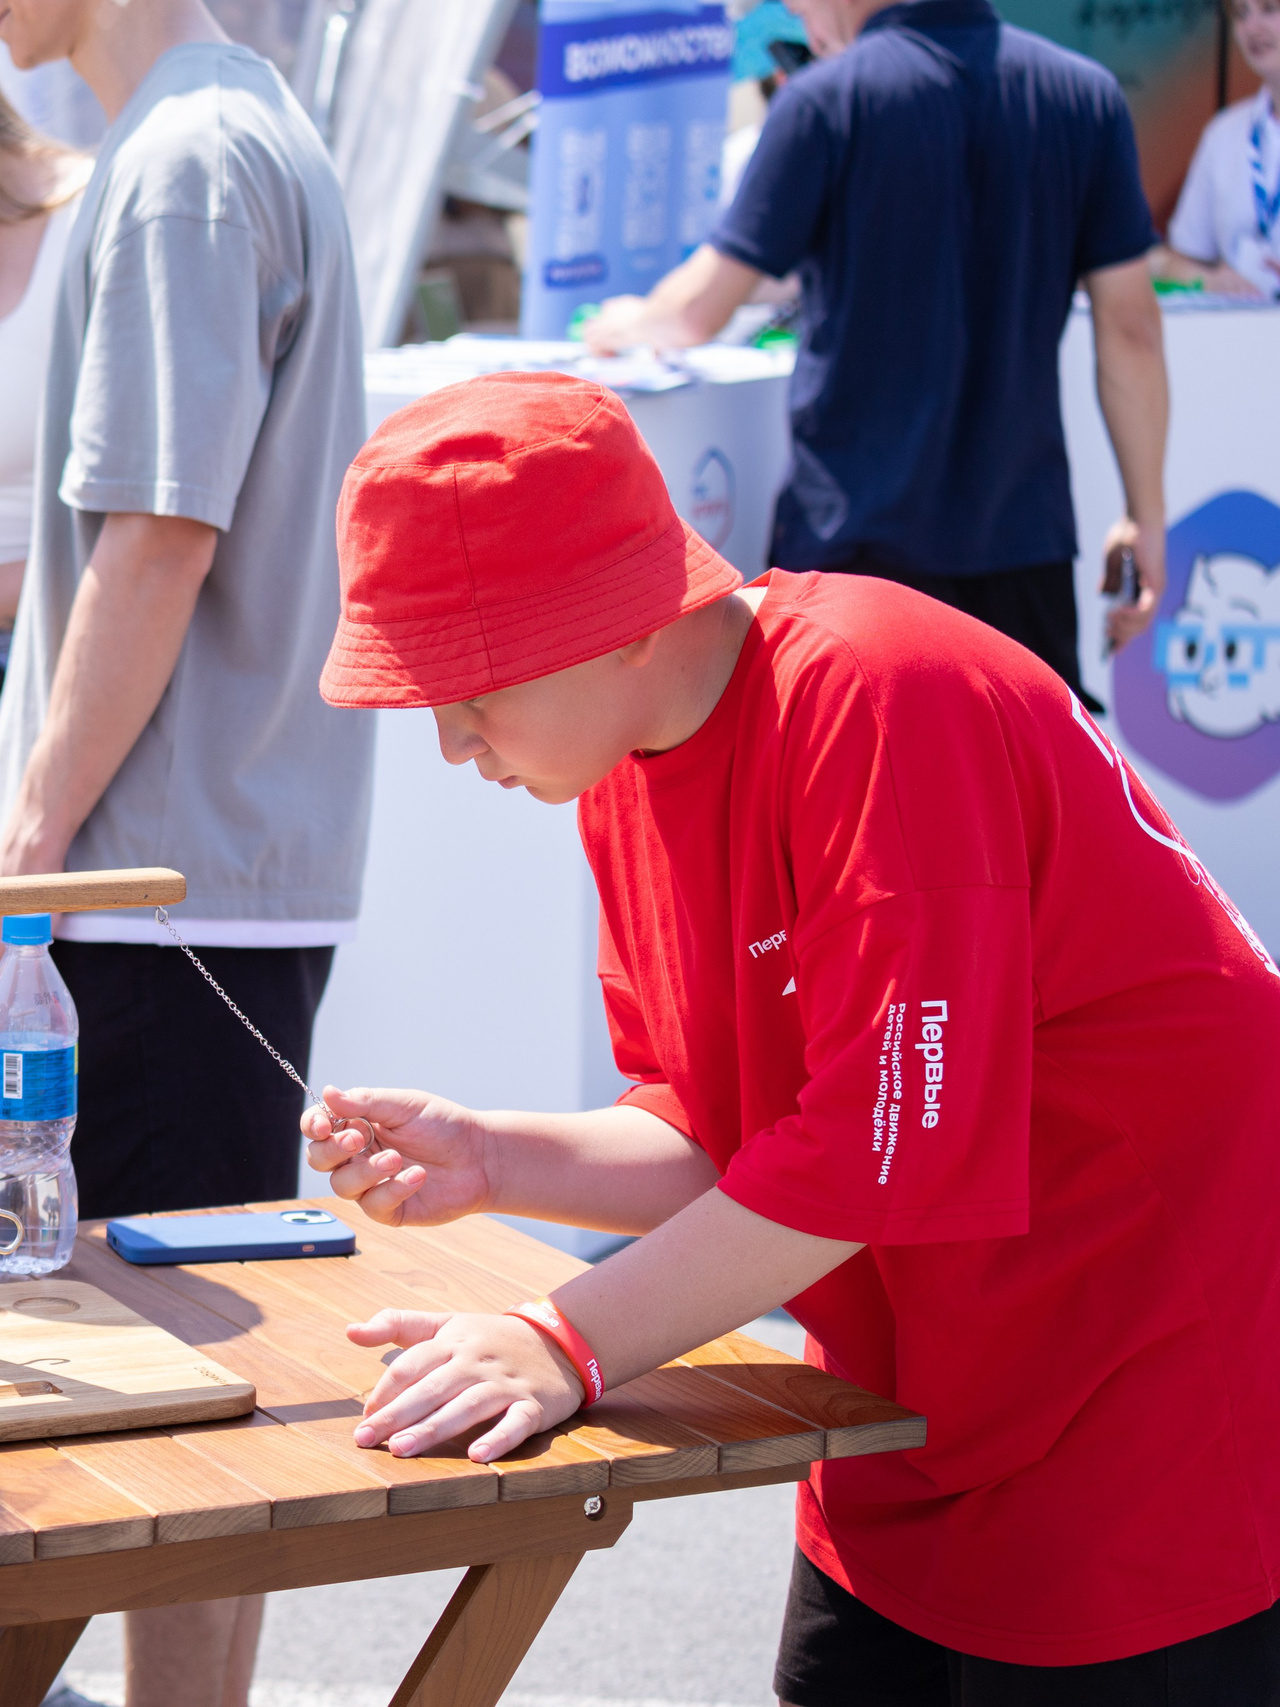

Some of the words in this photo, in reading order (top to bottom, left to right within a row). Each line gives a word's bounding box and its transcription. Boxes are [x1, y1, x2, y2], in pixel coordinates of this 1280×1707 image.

[878, 1055, 888, 1065] и
[882, 1004, 897, 1051] детей
[914, 1000, 949, 1129] Первые
[872, 1070, 889, 1152] молодёжи
[878, 1103, 901, 1185] движение
